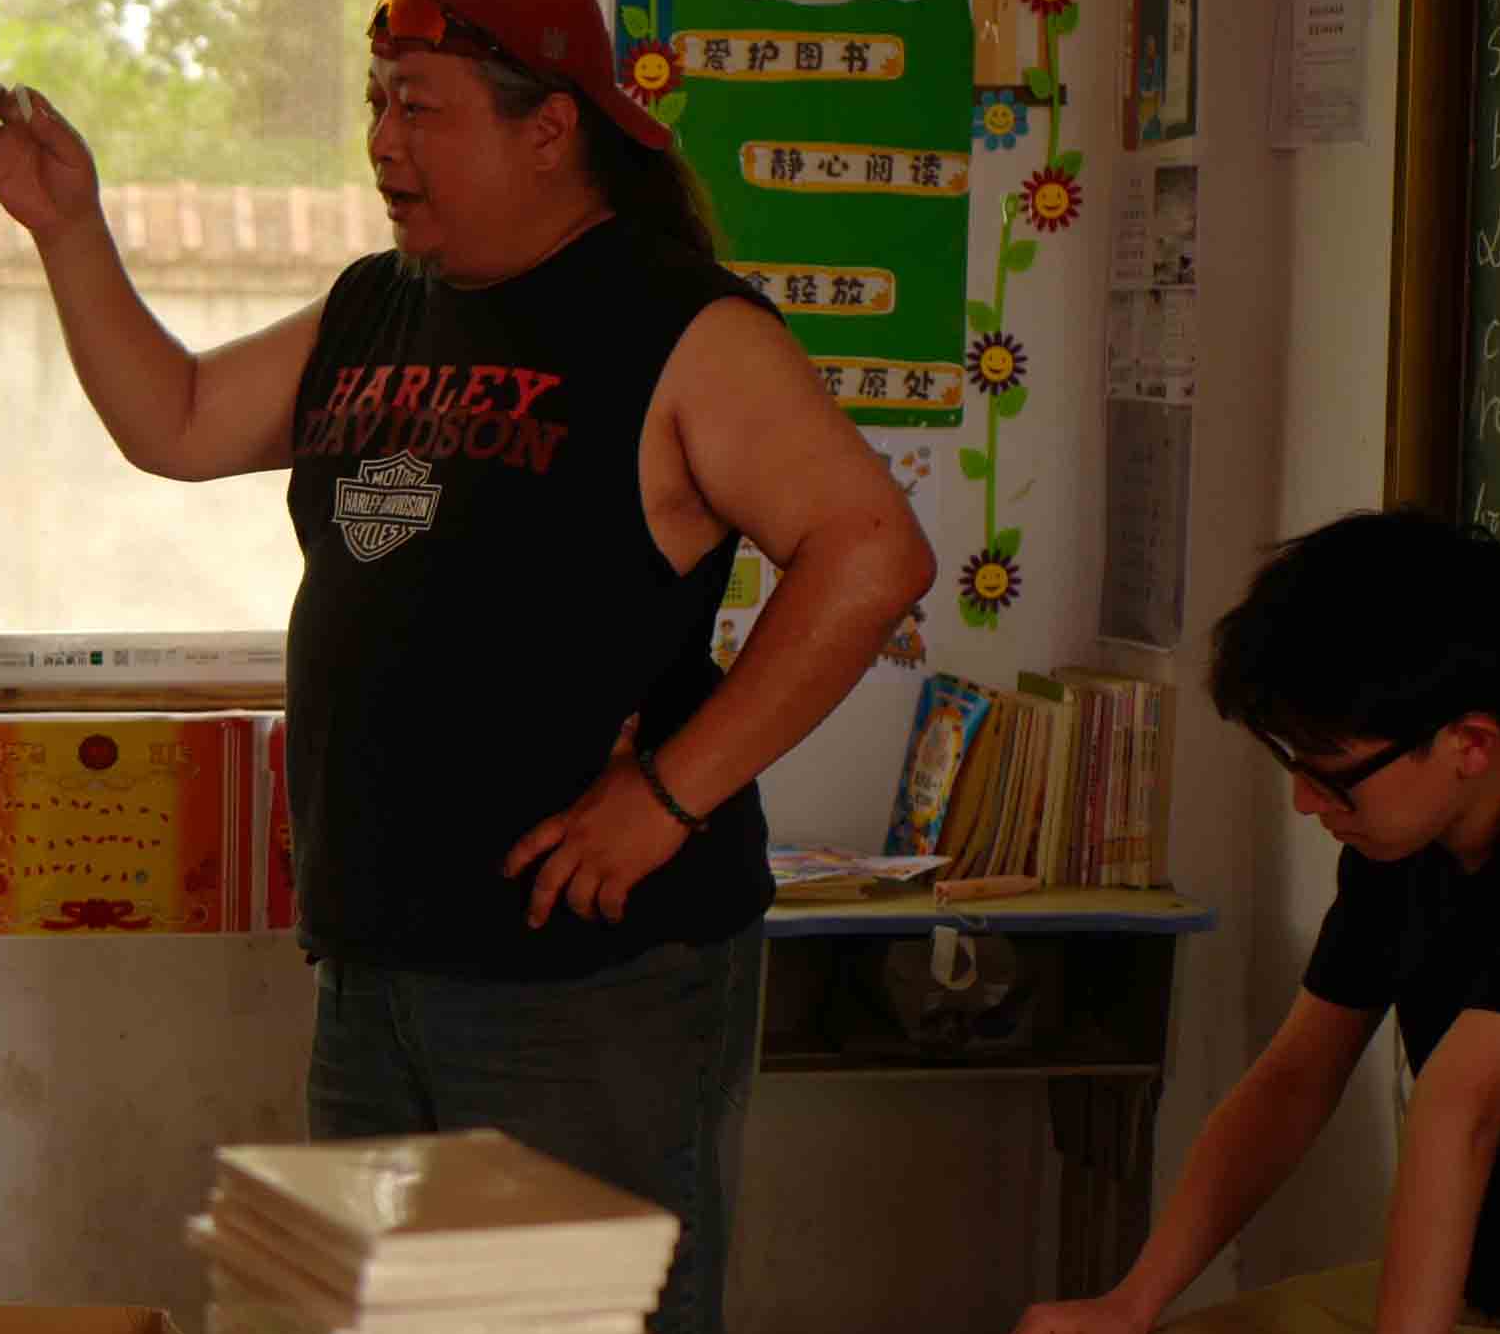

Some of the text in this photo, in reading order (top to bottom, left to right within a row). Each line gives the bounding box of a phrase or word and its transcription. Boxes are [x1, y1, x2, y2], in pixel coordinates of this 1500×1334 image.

[702, 38, 872, 75] 爱护图书
[770, 147, 942, 188] 静心阅读
[325, 363, 563, 419] HARLEY
[296, 407, 569, 475] DAVIDSON
